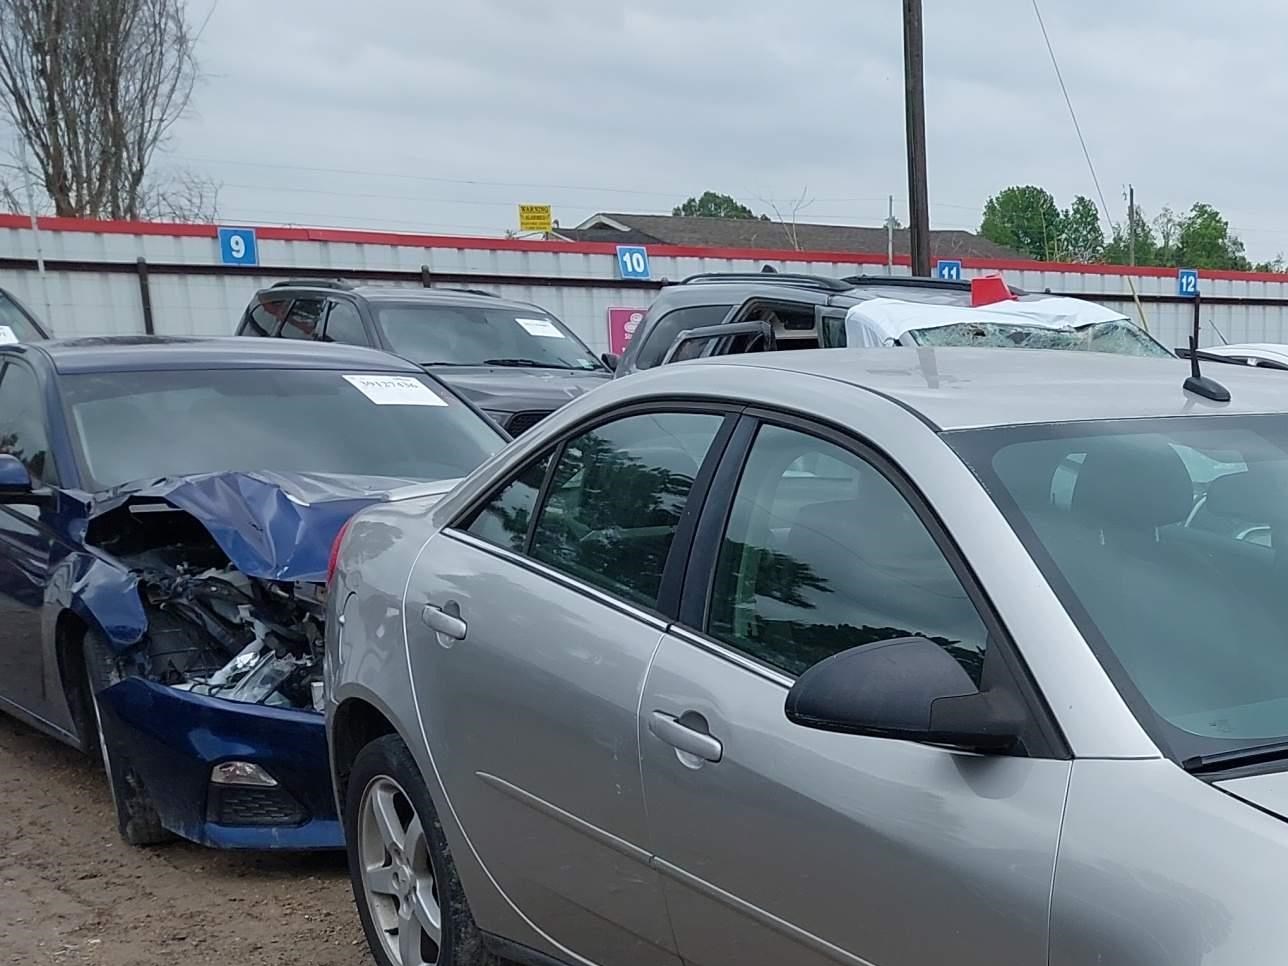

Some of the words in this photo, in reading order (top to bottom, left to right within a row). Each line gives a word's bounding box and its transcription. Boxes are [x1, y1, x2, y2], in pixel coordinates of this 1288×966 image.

[229, 234, 246, 259] 9
[622, 251, 645, 273] 10
[941, 265, 957, 281] 11
[1181, 274, 1196, 292] 12
